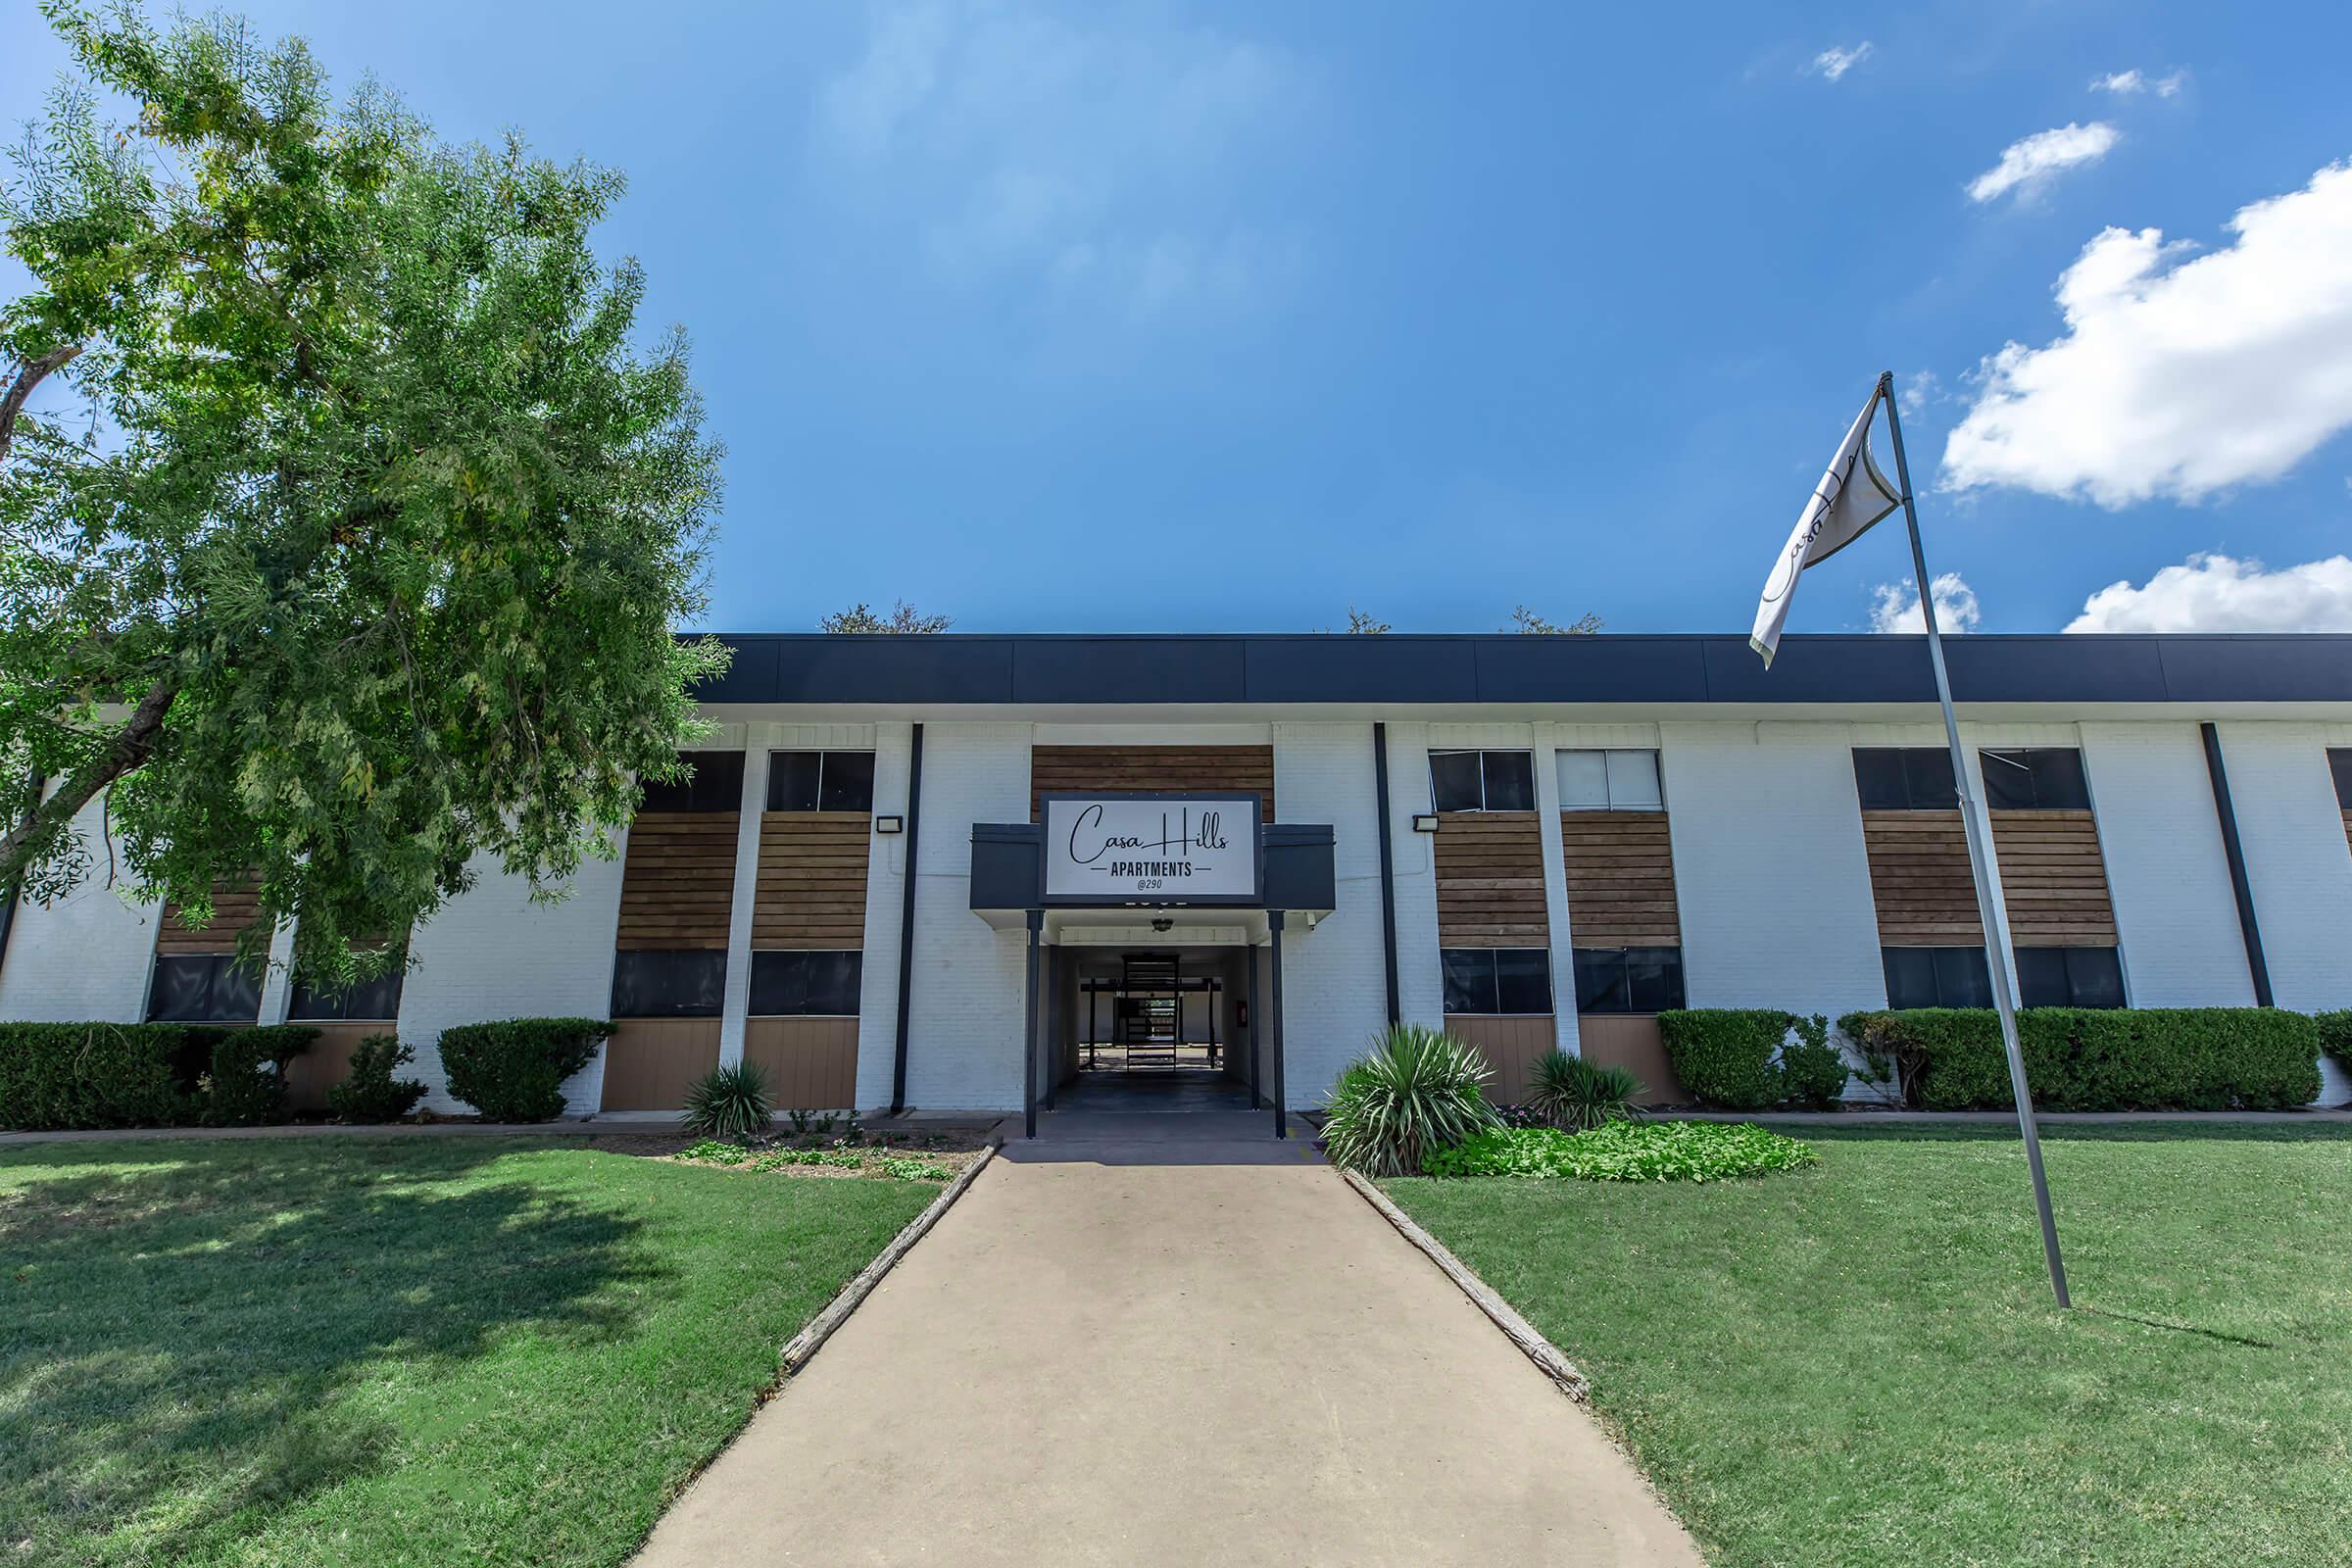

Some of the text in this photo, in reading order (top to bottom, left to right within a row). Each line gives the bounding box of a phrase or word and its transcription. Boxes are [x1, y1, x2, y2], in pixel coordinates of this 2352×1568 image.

[1069, 804, 1229, 864] Casa Hills
[1110, 861, 1192, 877] APARTMENTS
[1137, 879, 1162, 891] @290
